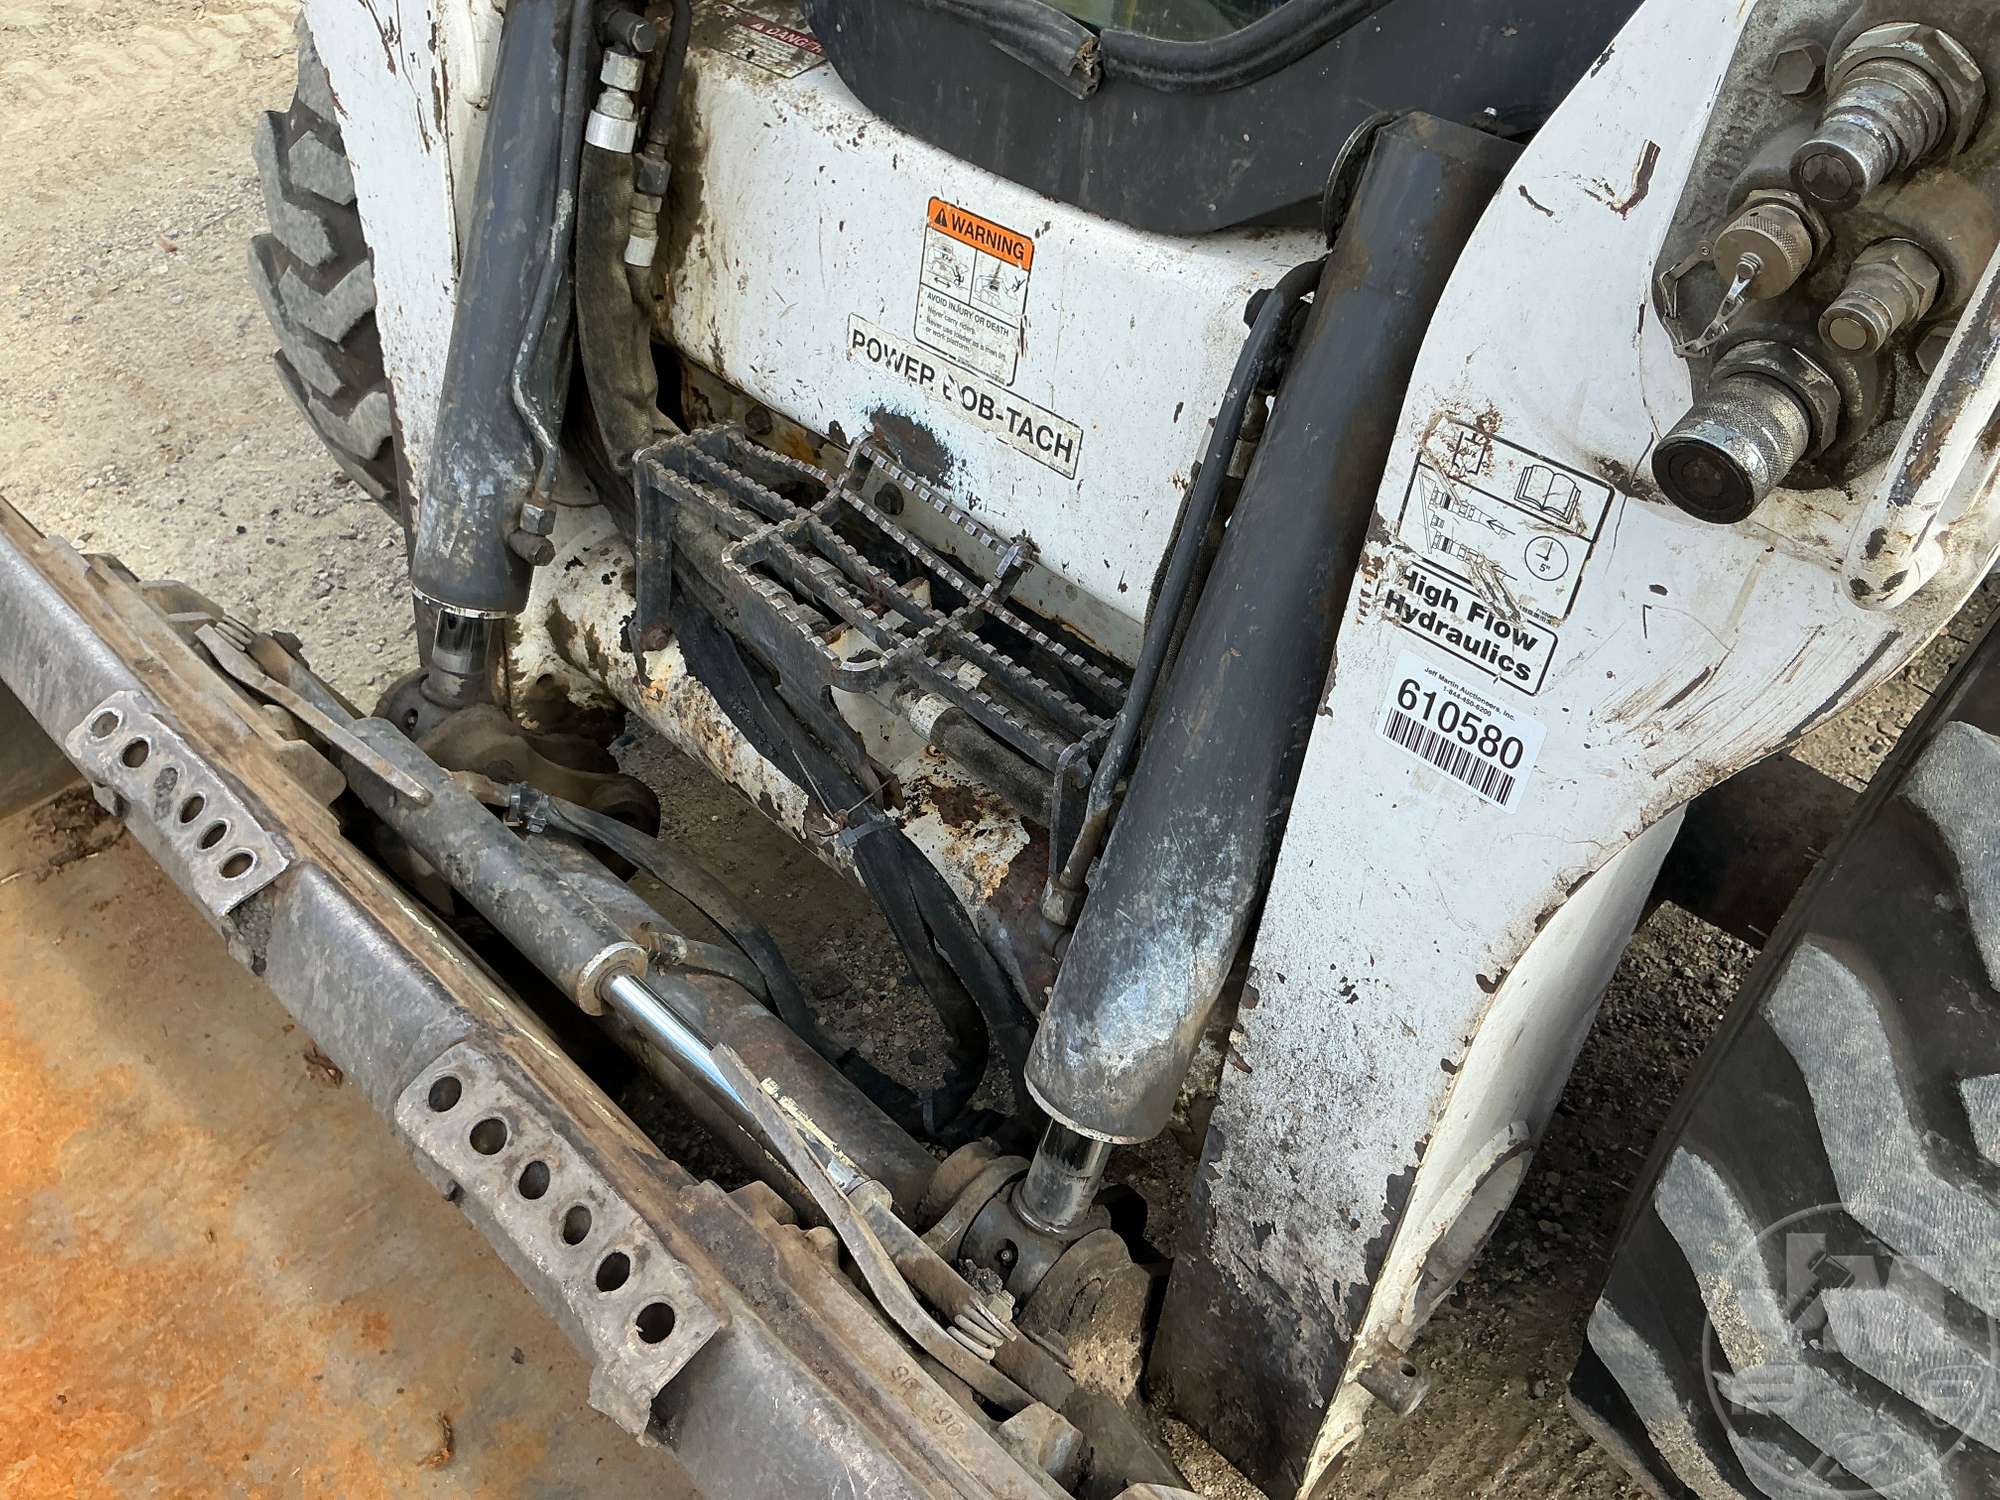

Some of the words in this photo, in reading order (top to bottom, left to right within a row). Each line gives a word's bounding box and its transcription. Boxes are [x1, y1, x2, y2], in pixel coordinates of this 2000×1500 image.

[951, 213, 1025, 261] WARNING
[927, 292, 948, 306] AVOID
[948, 302, 974, 319] INJURY
[974, 315, 985, 326] OR
[986, 320, 1009, 337] DEATH
[852, 329, 935, 386] POWER
[1384, 589, 1533, 682] Hydraulics
[1402, 570, 1460, 613] High
[1466, 601, 1539, 652] Flow
[1424, 667, 1438, 677] Jeff
[1438, 674, 1459, 690] Martin
[1460, 687, 1501, 714] Auctioneers,
[1502, 709, 1517, 722] Inc.
[1443, 686, 1492, 717] 1-844-450-6200
[1397, 678, 1524, 770] 610580
